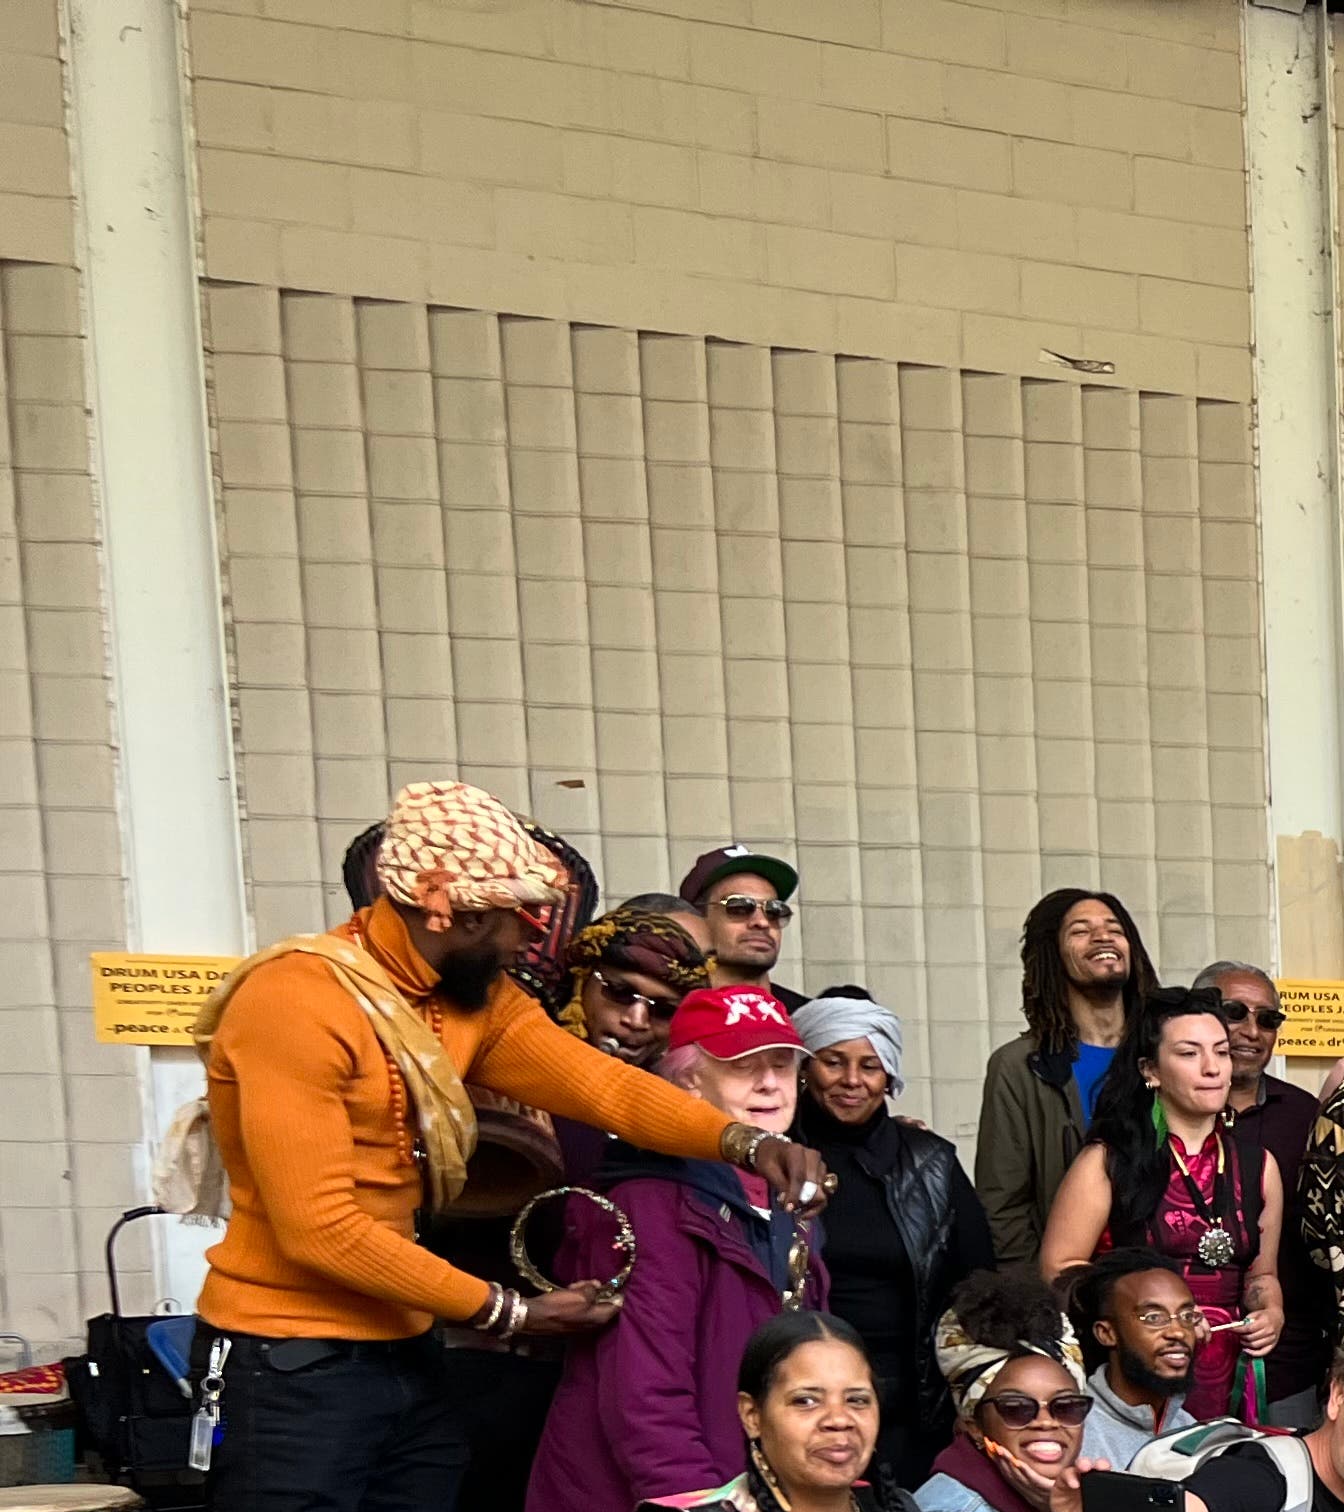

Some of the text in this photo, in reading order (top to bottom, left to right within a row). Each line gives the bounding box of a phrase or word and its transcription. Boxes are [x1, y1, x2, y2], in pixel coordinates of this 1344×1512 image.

[101, 967, 230, 981] DRUM USA DA
[109, 982, 215, 995] PEOPLES JA
[1280, 991, 1310, 1000] RUM
[1313, 992, 1340, 1001] USA
[1280, 1003, 1333, 1014] EOPLES
[113, 1023, 169, 1035] peace
[1278, 1037, 1317, 1048] peace
